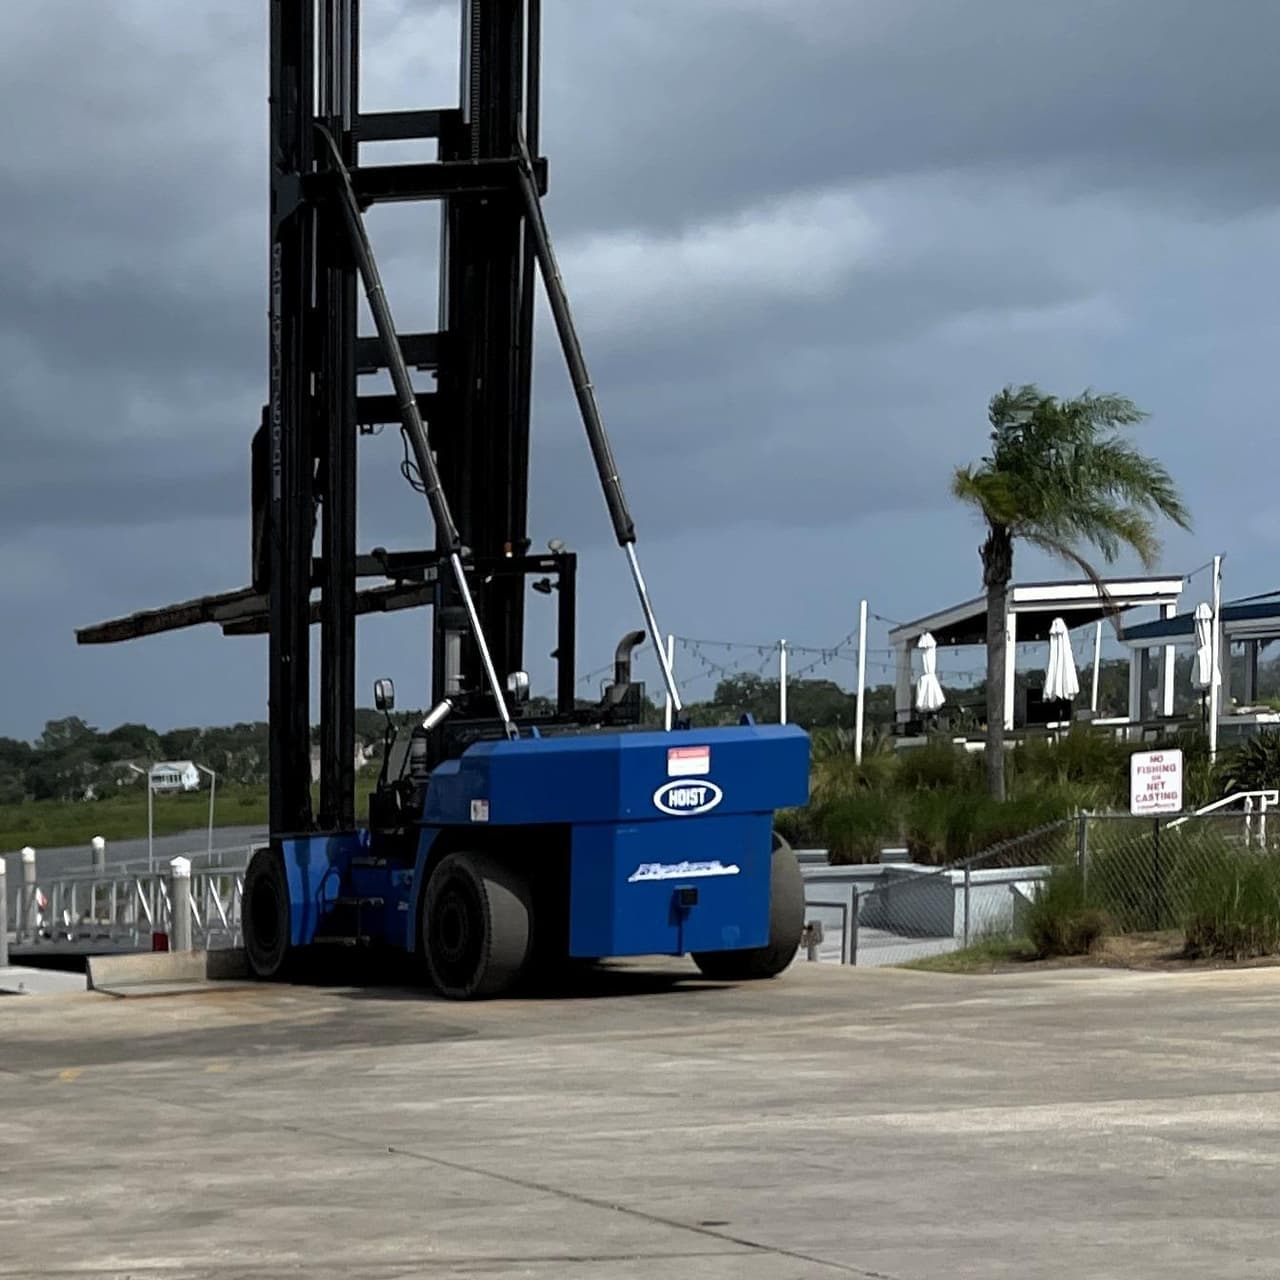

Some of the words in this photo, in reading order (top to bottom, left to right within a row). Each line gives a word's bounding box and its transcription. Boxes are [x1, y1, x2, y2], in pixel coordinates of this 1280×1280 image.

[1150, 755, 1164, 763] NO
[1137, 763, 1176, 775] FISHING
[1146, 781, 1166, 790] NET
[668, 787, 707, 808] HOIST
[1135, 791, 1178, 803] CASTING
